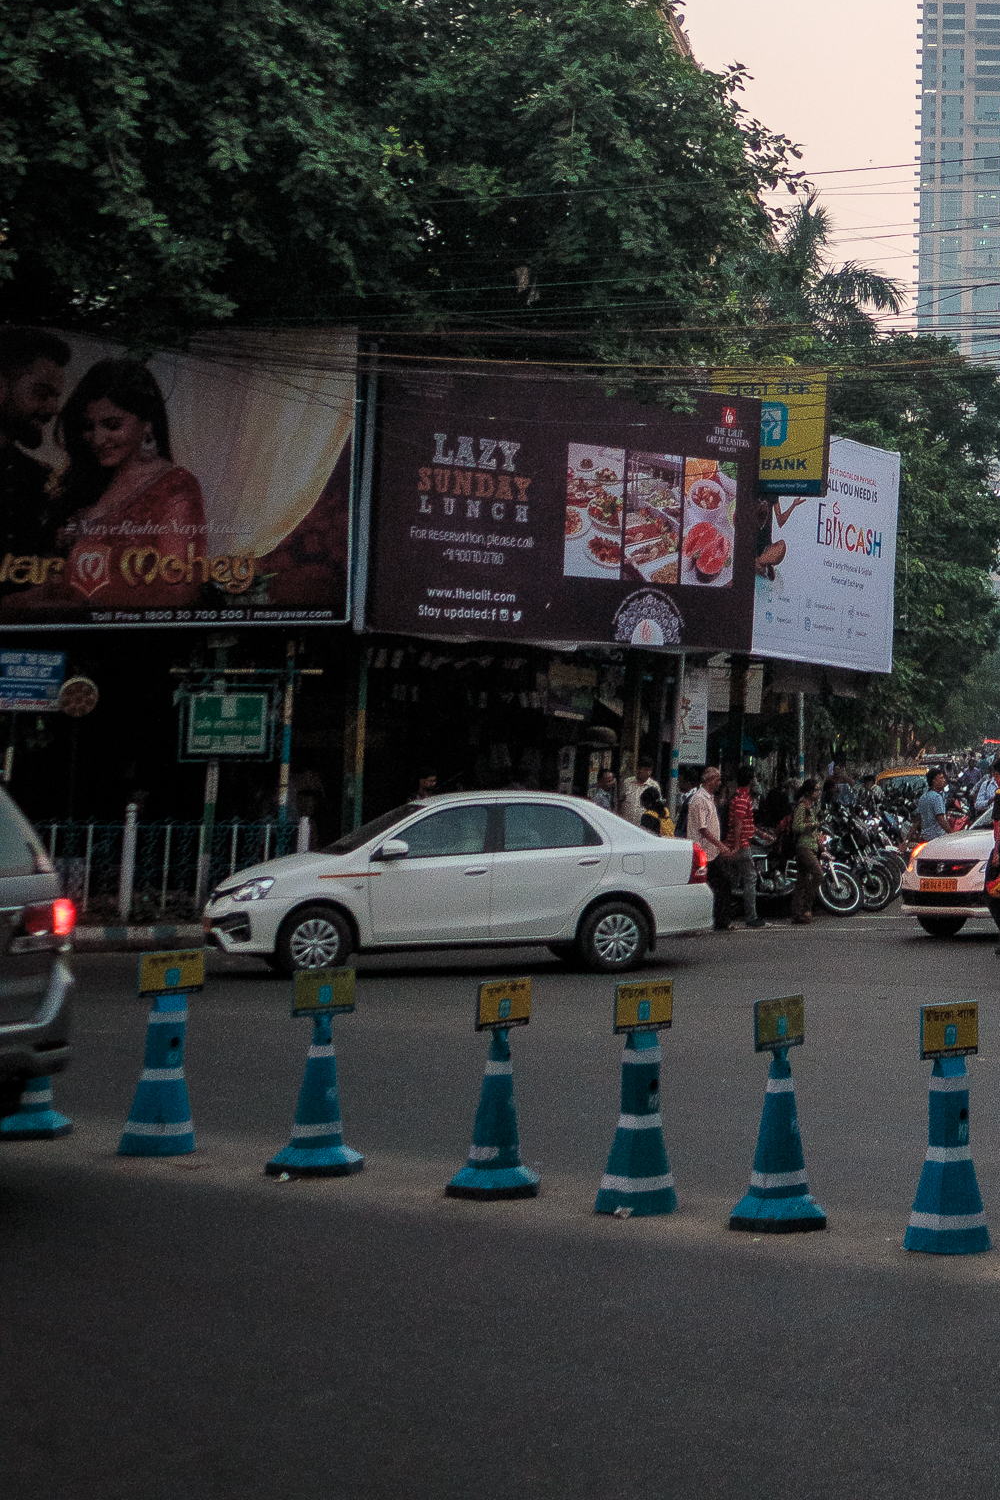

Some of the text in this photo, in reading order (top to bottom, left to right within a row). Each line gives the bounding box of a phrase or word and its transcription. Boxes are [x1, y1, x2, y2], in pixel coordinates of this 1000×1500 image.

[432, 431, 521, 472] LAZY
[761, 458, 807, 471] BANK
[417, 466, 532, 503] SUNDAY
[828, 479, 878, 503] ALL YOU NEED IS
[418, 495, 529, 523] LUNCH
[486, 532, 516, 549] please
[120, 542, 255, 595] Mohey
[427, 587, 517, 603] www.thelalit.com
[91, 611, 112, 621] Toll
[115, 610, 141, 621] Free
[145, 610, 173, 620] 1800
[194, 609, 217, 620] 700
[220, 609, 243, 619] 500
[253, 608, 332, 619] manyavar.com
[418, 604, 441, 619] Stay
[443, 606, 490, 620] updated:
